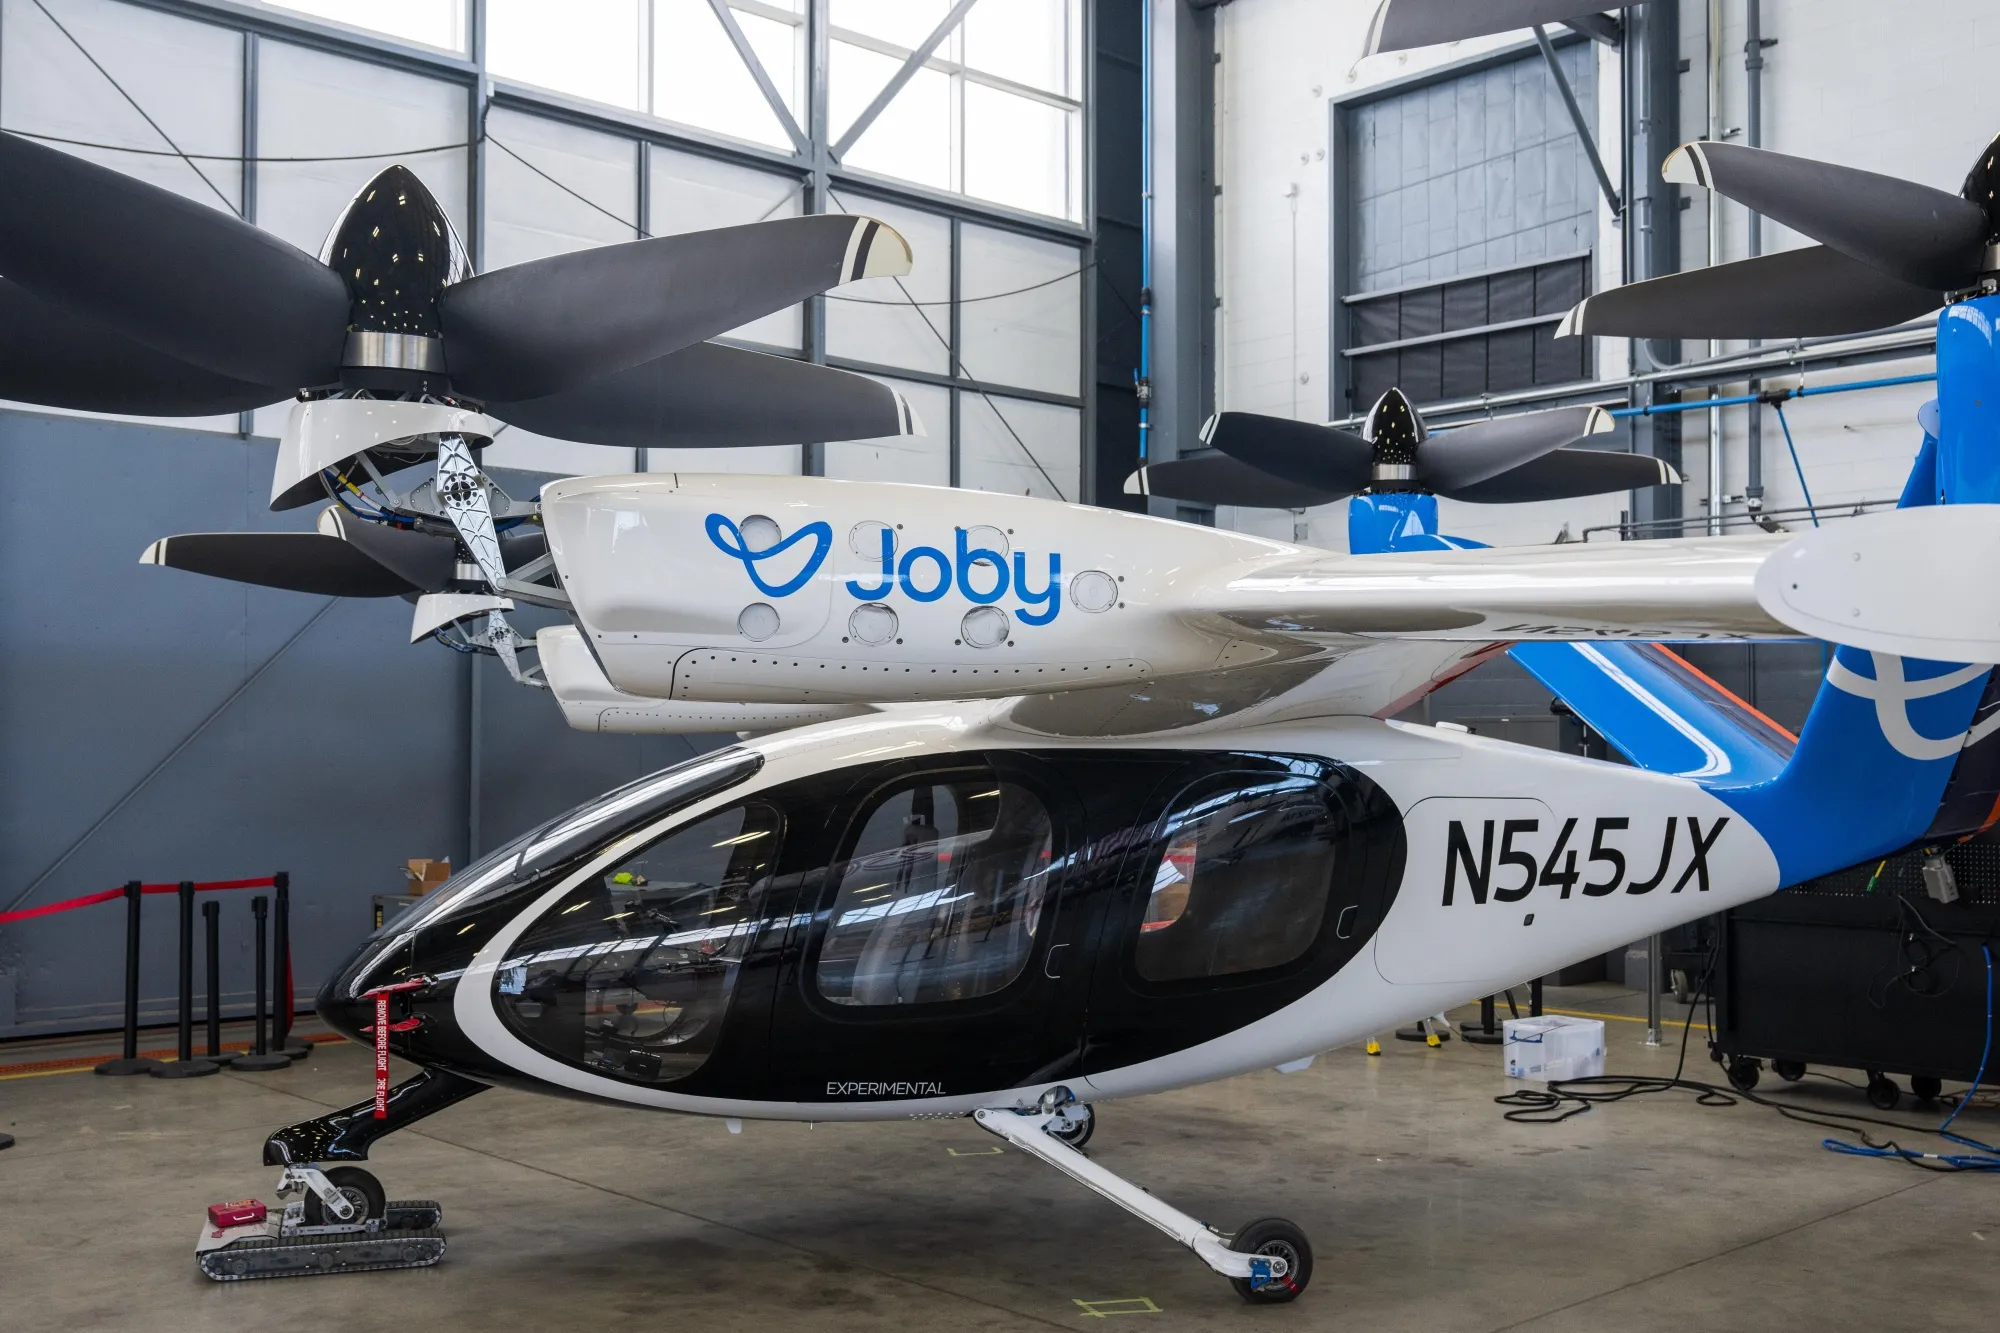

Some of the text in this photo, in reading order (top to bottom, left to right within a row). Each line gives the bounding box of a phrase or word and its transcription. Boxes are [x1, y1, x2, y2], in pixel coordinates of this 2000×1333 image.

[845, 528, 1061, 626] Joby
[1442, 816, 1730, 906] N545JX
[377, 1000, 387, 1071] REMOVE BEFORE FLIGHT
[376, 1090, 385, 1111] FLIGHT
[826, 1081, 946, 1095] EXPERIMENTAL
